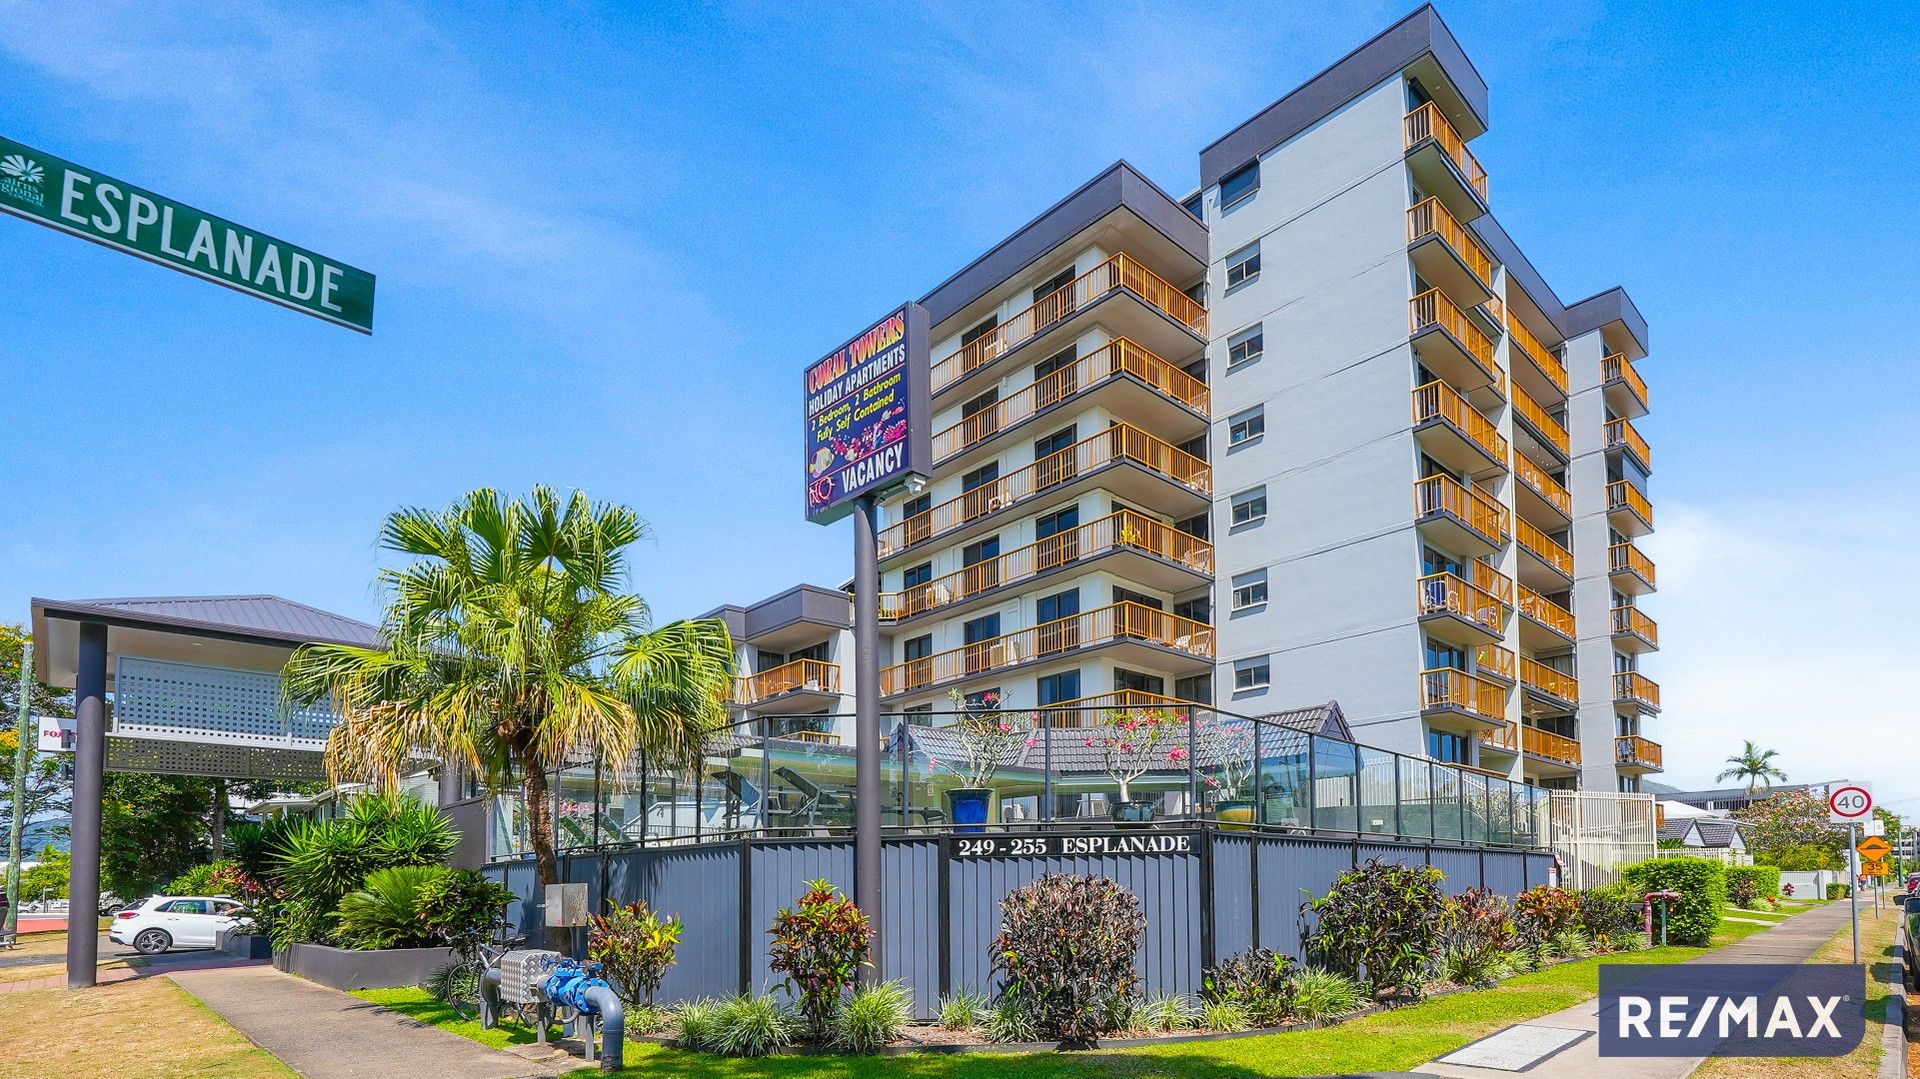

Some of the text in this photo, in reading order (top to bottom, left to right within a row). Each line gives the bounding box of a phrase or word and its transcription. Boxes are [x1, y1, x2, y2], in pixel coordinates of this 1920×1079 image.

[60, 168, 344, 312] ESPLANADE
[808, 310, 905, 394] CORAL TOWERS
[808, 344, 905, 417] HOLIDAY APARTMENTS
[811, 420, 816, 432] 2
[855, 394, 860, 406] 2
[863, 373, 901, 401] Bathroom
[817, 388, 895, 443] Fully Self Contained
[809, 442, 904, 508] NO VACANCY
[1837, 795, 1865, 808] 40
[958, 839, 995, 856] 249
[1011, 839, 1047, 855] 255
[1062, 836, 1190, 853] ESPLANADE
